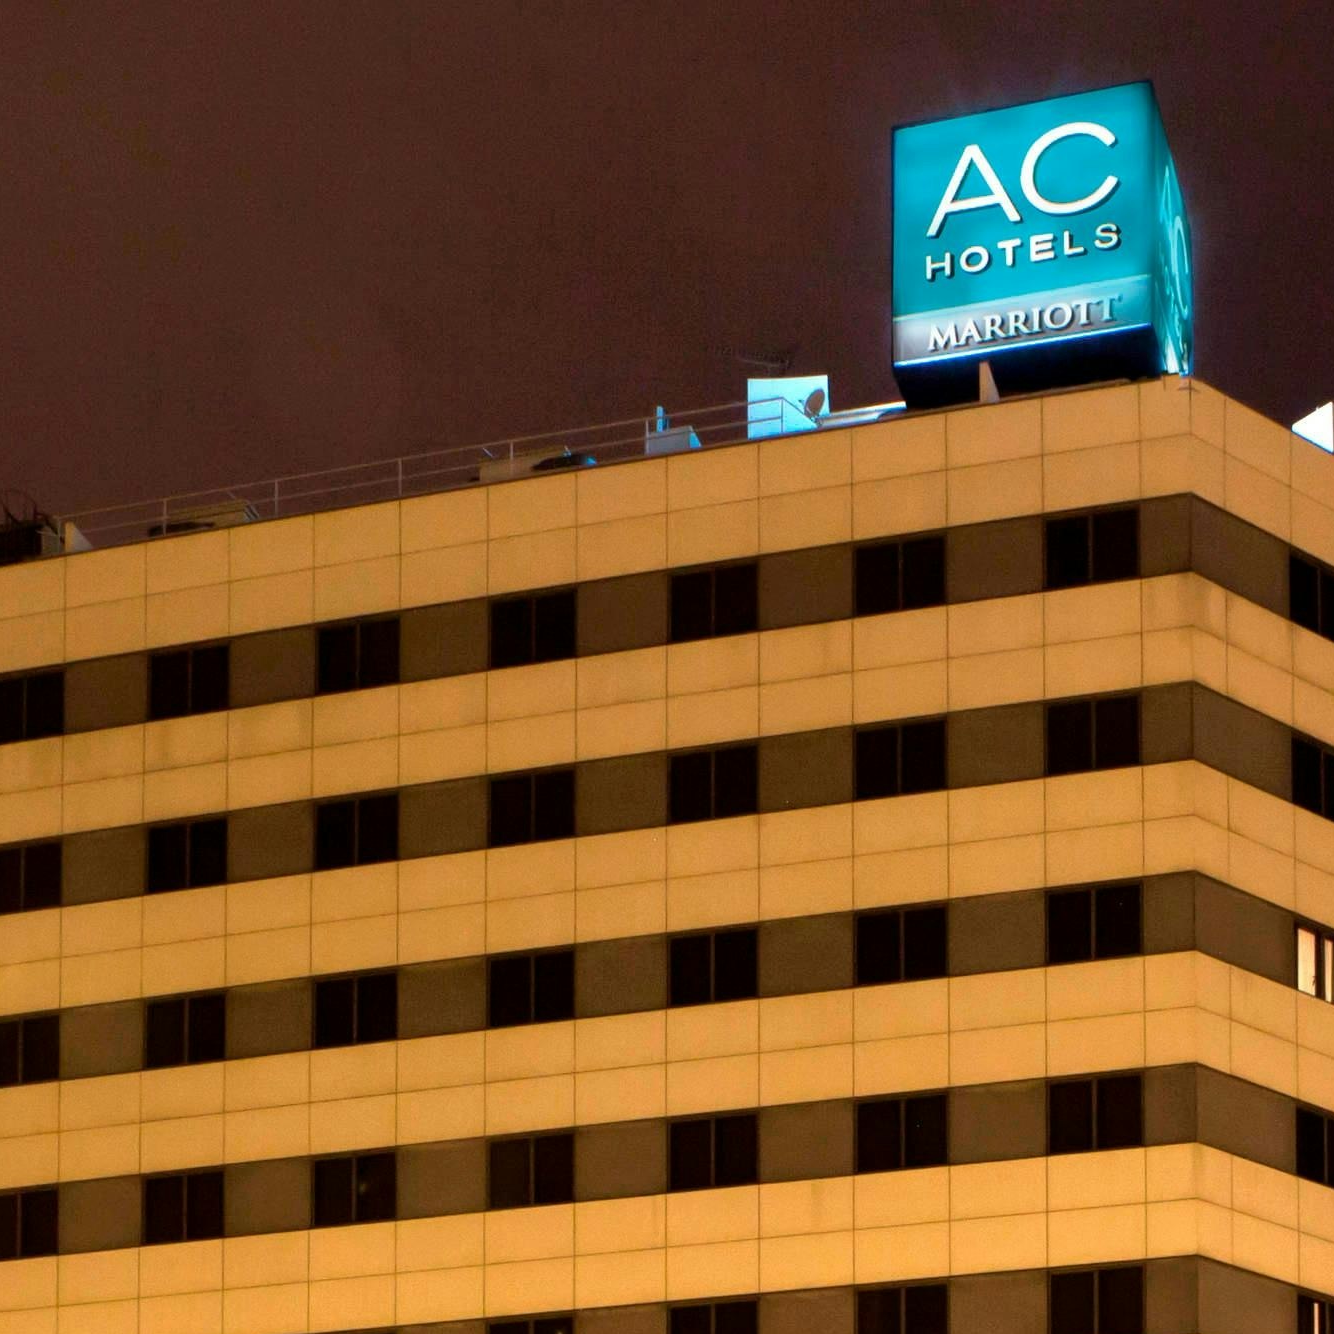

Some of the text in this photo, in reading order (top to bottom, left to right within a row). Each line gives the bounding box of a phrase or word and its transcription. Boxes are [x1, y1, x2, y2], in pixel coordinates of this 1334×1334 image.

[926, 121, 1118, 238] AC
[925, 223, 1120, 280] HOTELS
[927, 297, 1118, 351] MARRIOTT
